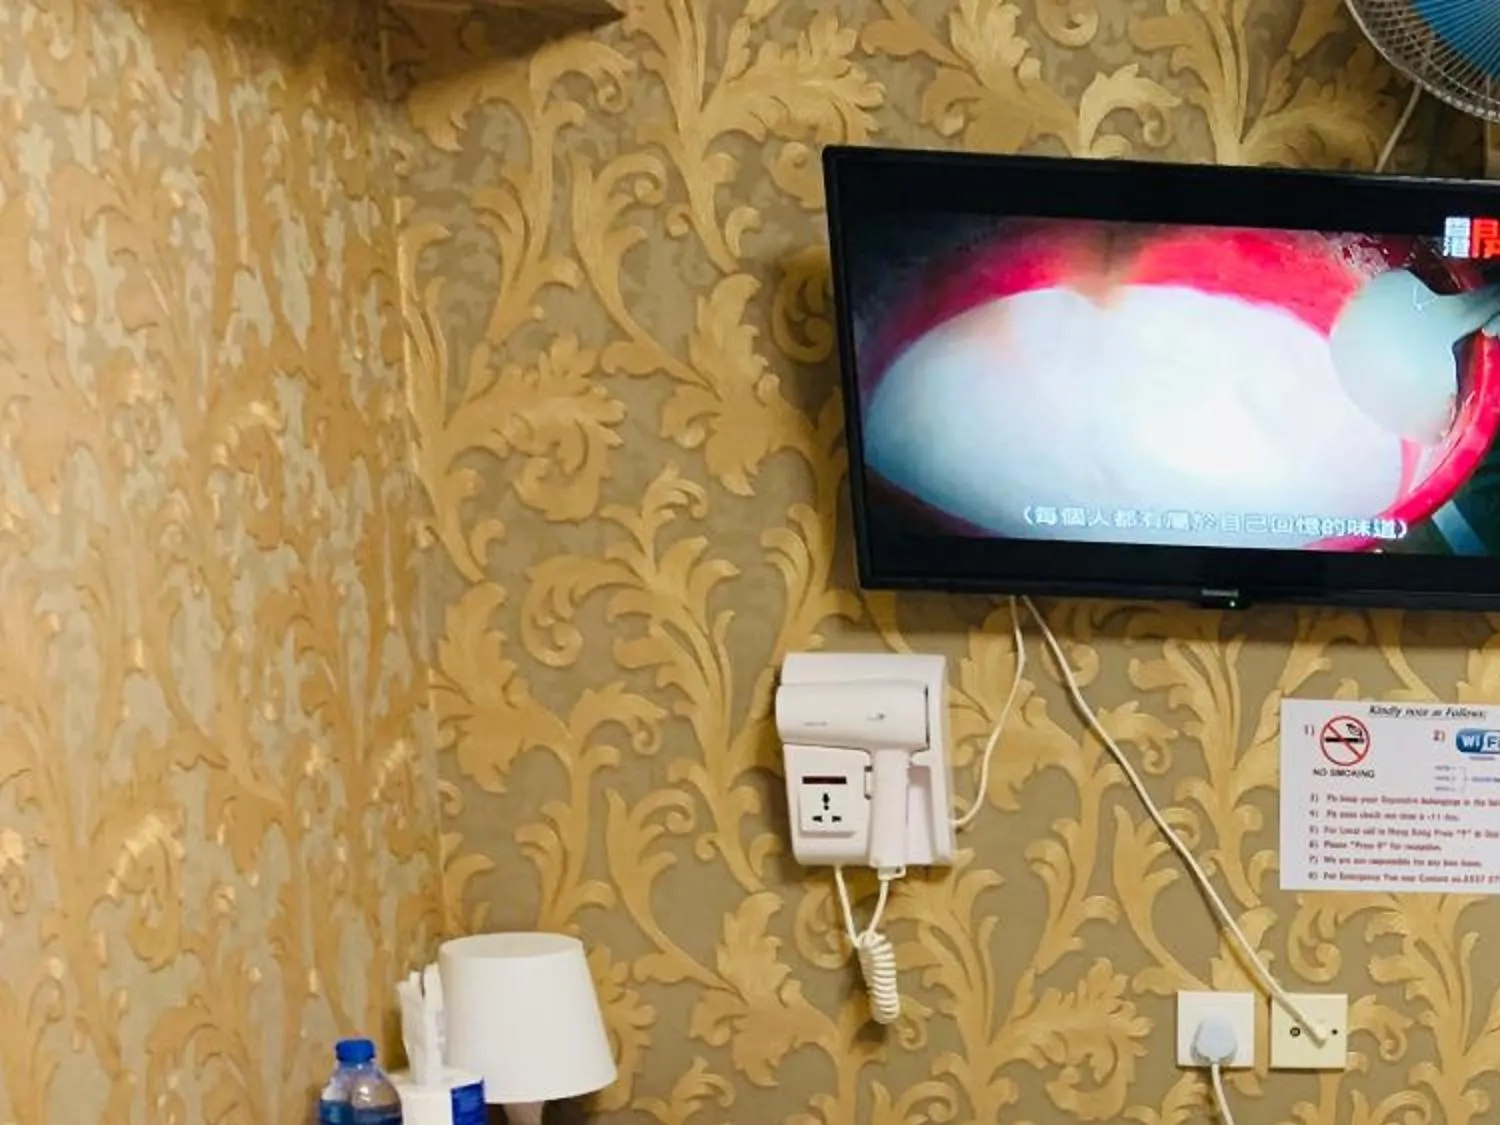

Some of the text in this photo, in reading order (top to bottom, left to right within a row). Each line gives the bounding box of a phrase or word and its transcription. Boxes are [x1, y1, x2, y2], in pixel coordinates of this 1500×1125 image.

[1369, 705, 1401, 717] Kindly
[1313, 769, 1375, 779] NO SMOKING
[1323, 840, 1347, 849] Please
[1323, 872, 1336, 880] For
[1339, 872, 1380, 883] Emergency
